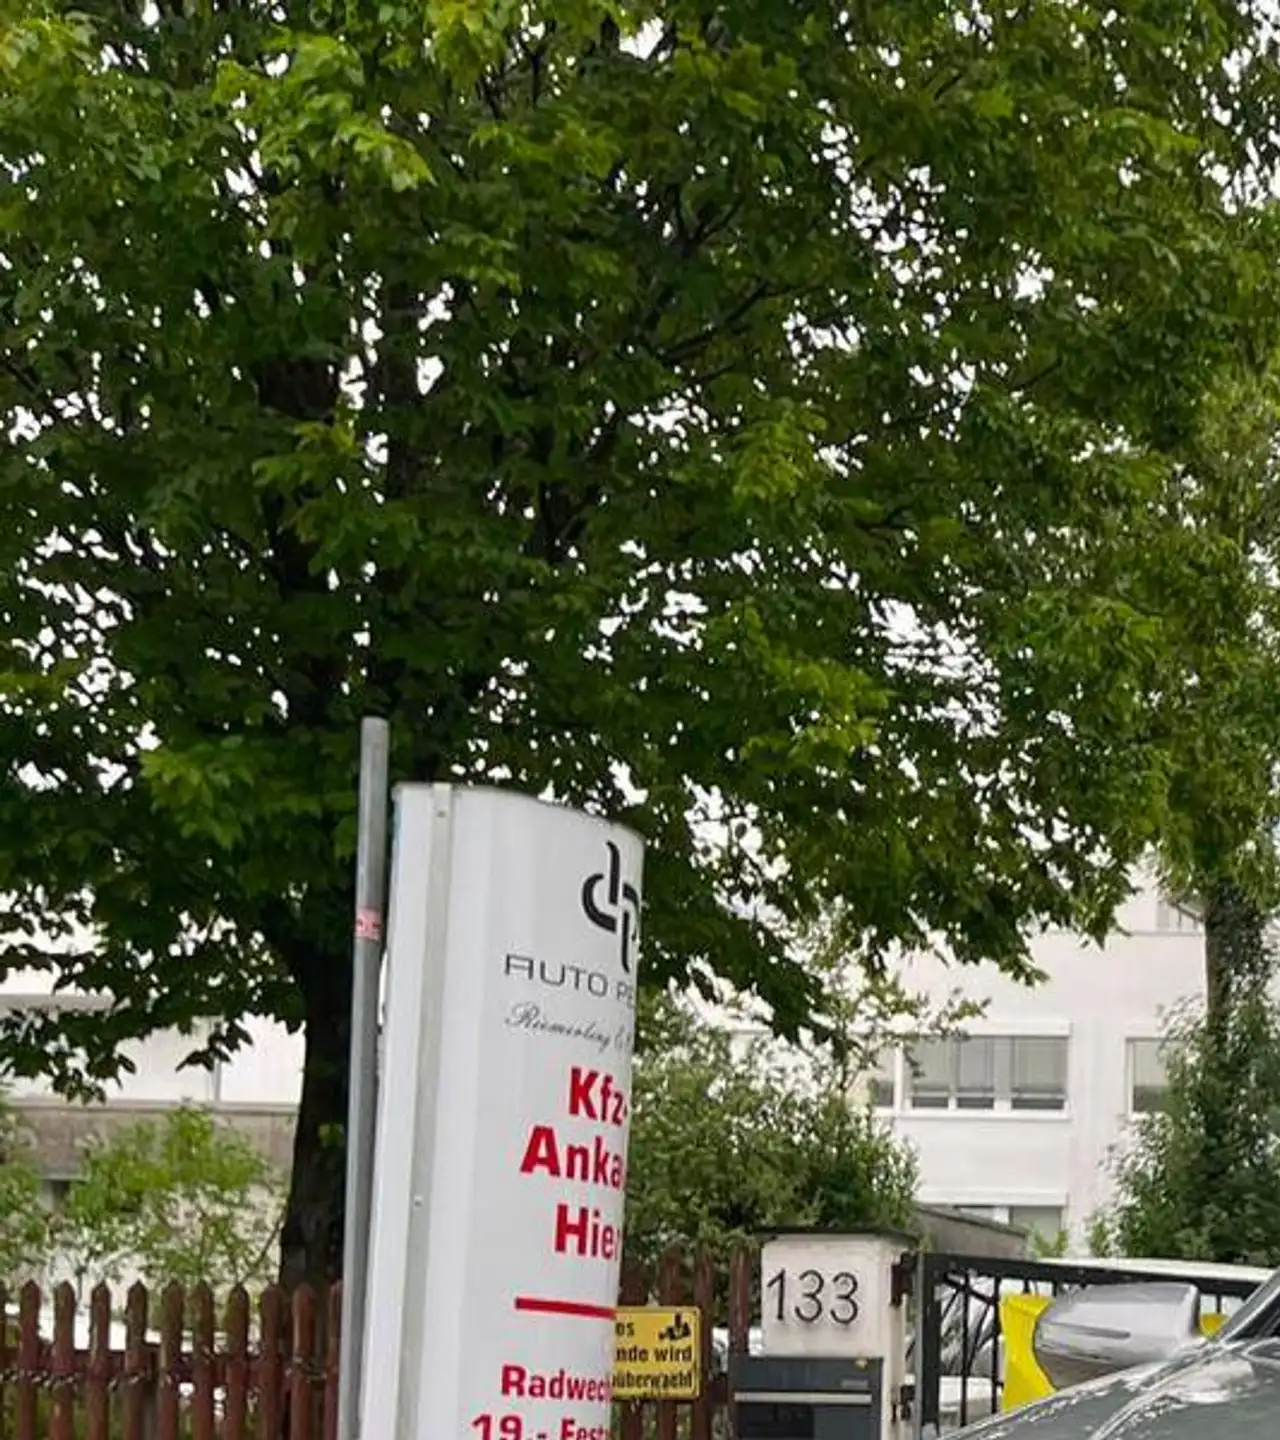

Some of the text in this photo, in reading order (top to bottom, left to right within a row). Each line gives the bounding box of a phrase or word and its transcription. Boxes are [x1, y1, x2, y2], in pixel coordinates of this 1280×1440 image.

[505, 953, 609, 998] AUTO
[766, 1268, 859, 1325] 133
[654, 1344, 692, 1362] wird
